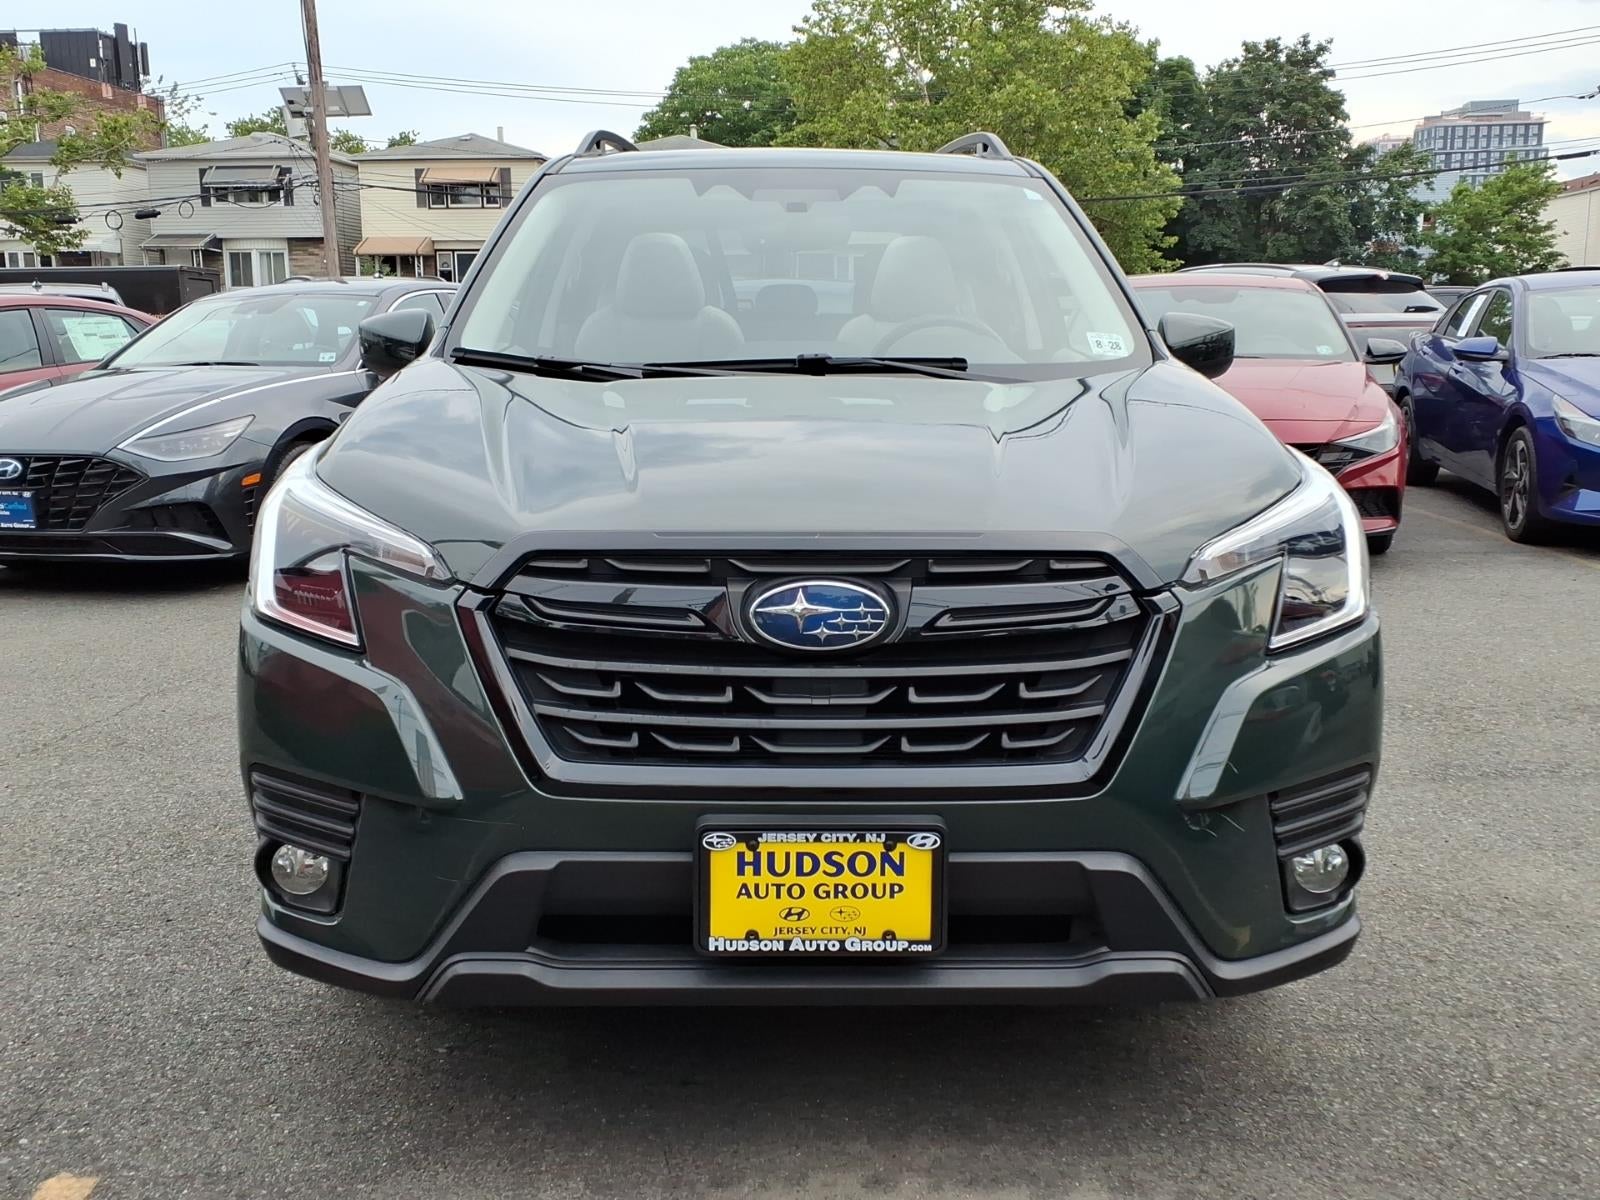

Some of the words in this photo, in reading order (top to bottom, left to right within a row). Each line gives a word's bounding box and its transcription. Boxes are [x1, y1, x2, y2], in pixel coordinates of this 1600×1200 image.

[1096, 340, 1103, 349] 8
[1108, 341, 1122, 350] 28
[758, 833, 817, 843] JERSEY
[820, 833, 860, 843] CITY,
[865, 833, 886, 843] NJ
[736, 851, 905, 877] HUDSON
[736, 882, 806, 900] AUTO
[813, 882, 904, 900] GROUP
[773, 926, 817, 937] JERSEY
[820, 926, 851, 936] CITY,
[854, 926, 867, 937] NJ
[708, 936, 785, 952] HUDSON
[788, 936, 840, 952] AUTO
